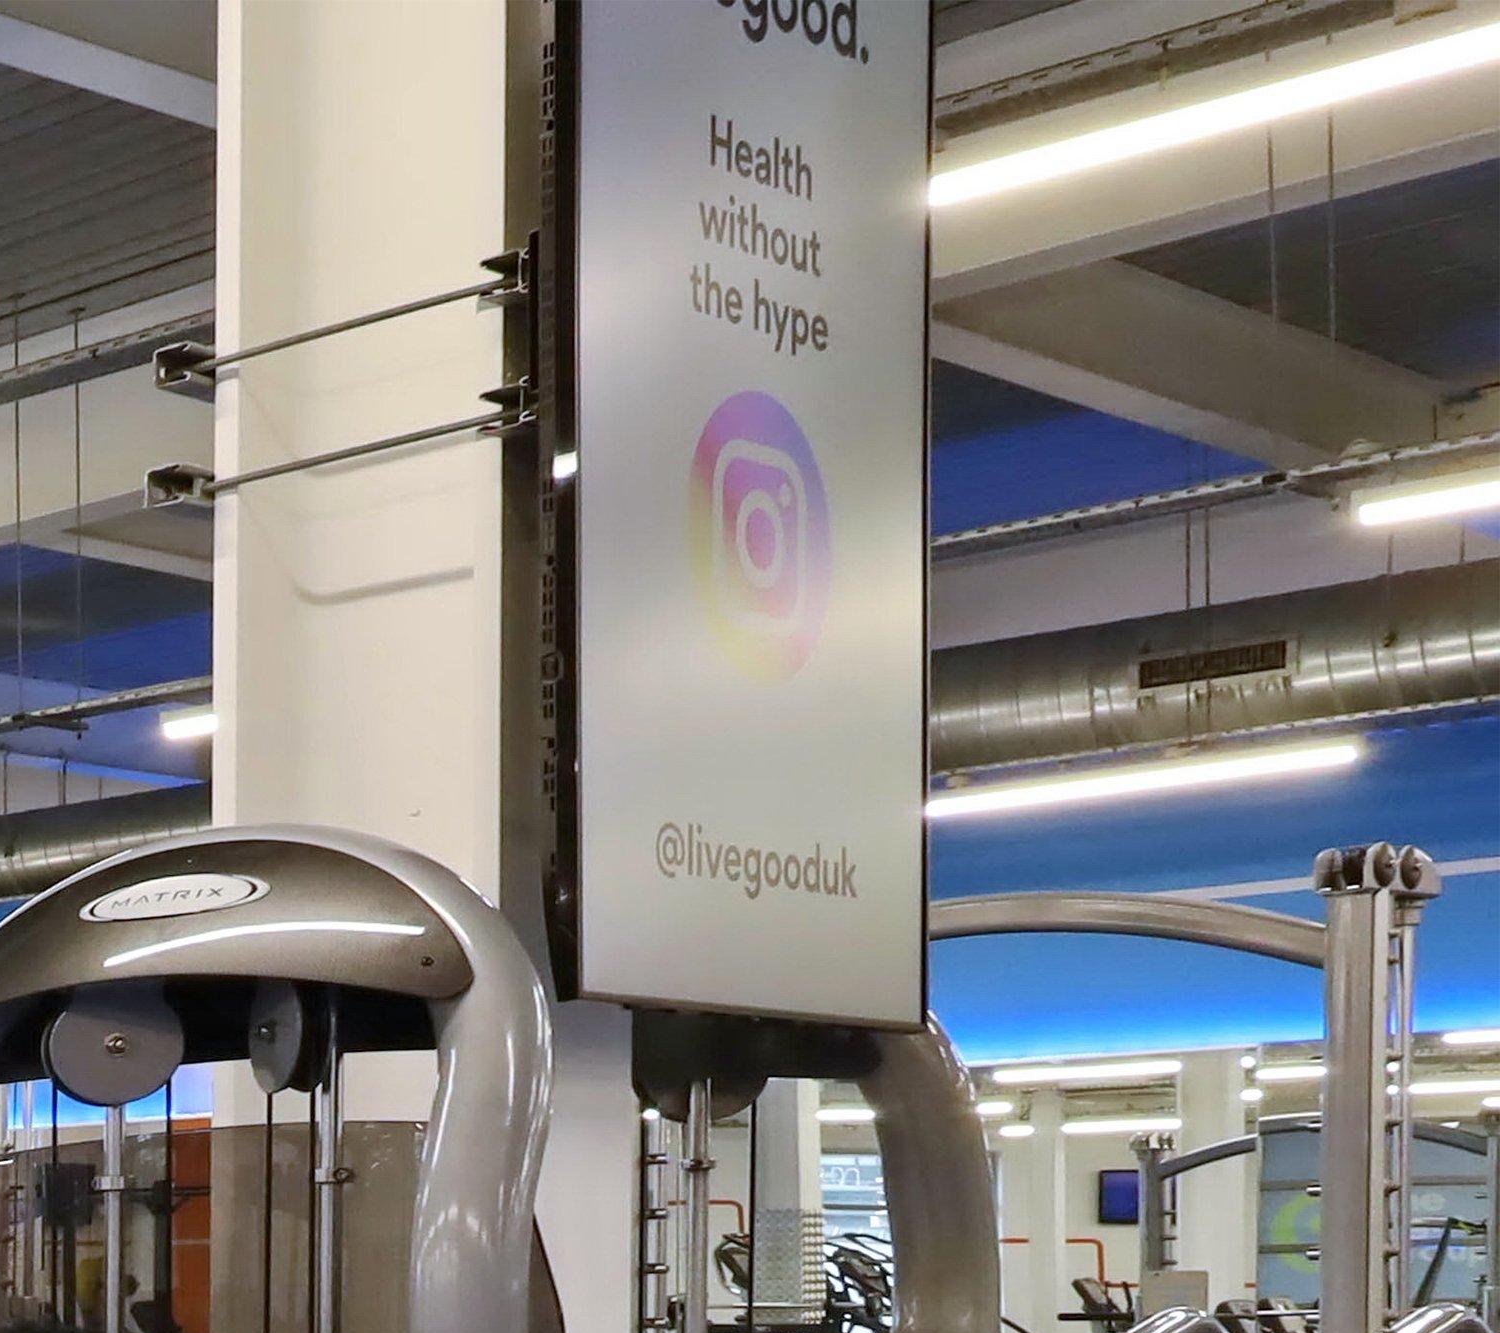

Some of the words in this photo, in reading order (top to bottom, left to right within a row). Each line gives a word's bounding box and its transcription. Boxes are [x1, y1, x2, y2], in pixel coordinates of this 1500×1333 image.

[717, 0, 869, 64] good.
[710, 114, 812, 201] Health
[699, 195, 821, 277] without
[690, 263, 742, 324] the
[754, 278, 829, 356] hype
[110, 886, 225, 910] MATRIX
[656, 822, 857, 899] @livegooduk
